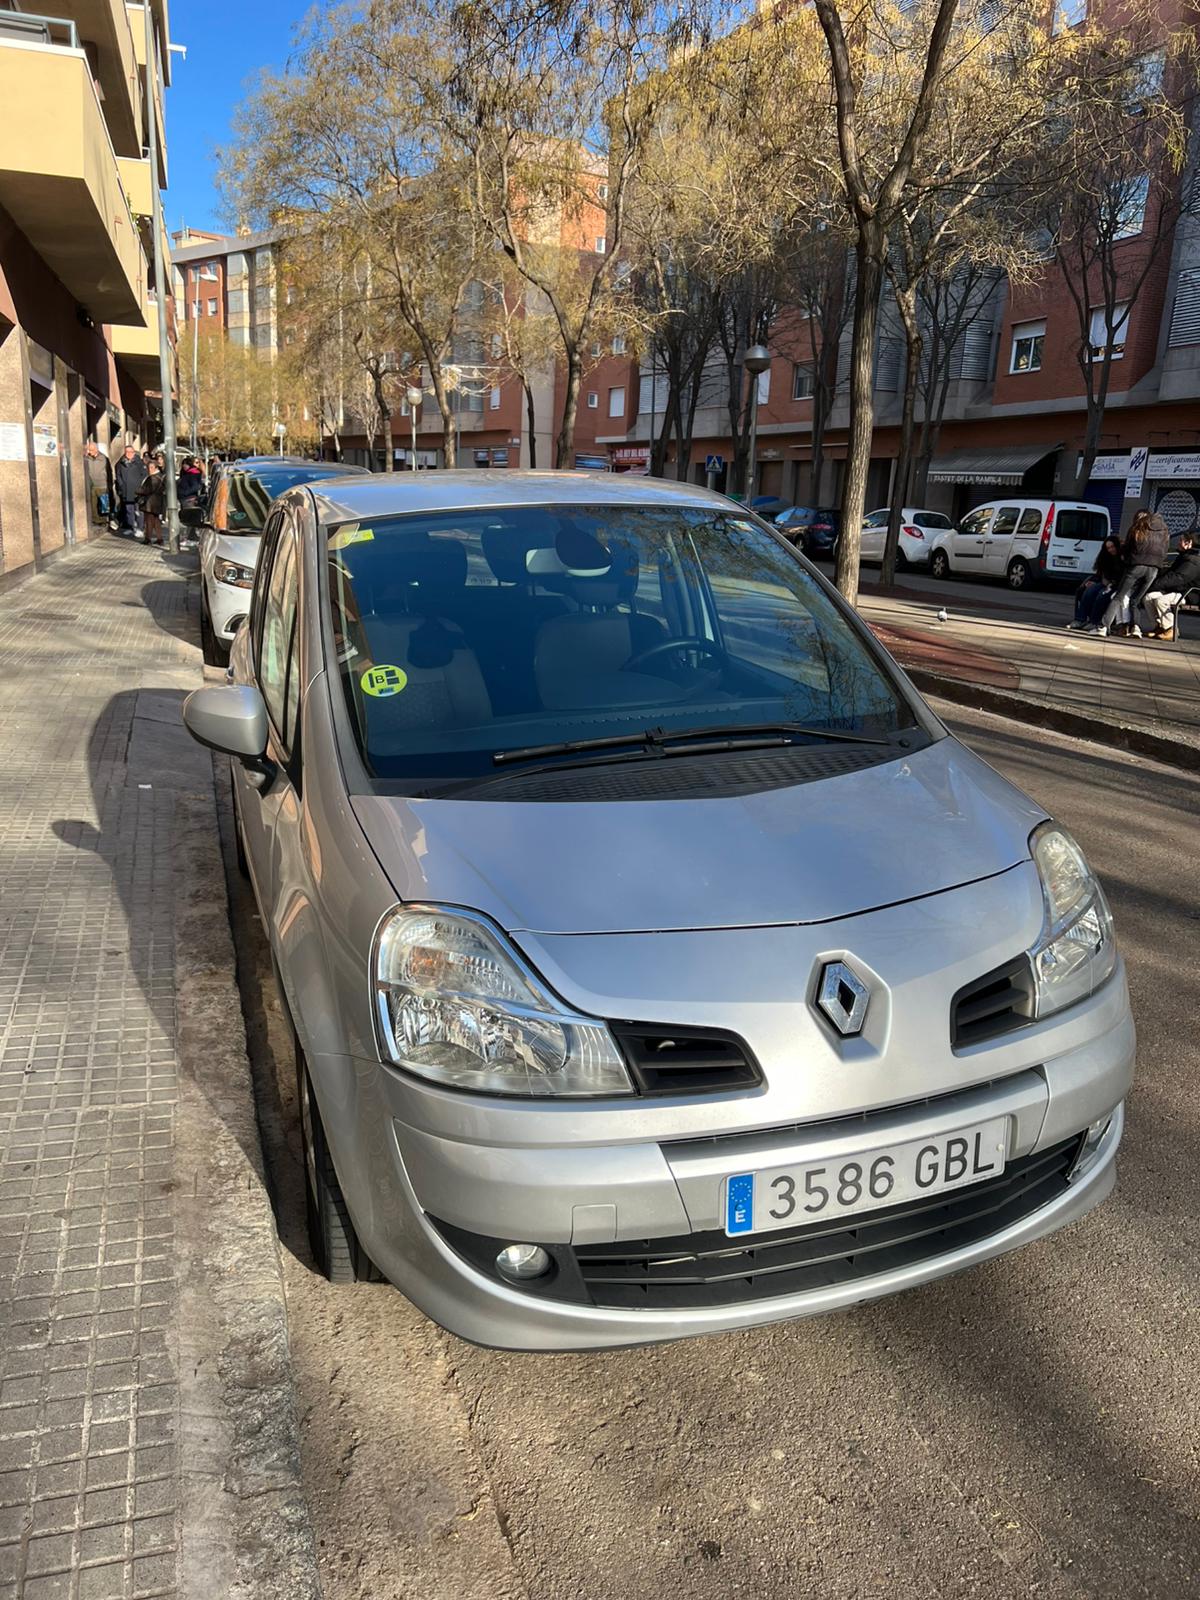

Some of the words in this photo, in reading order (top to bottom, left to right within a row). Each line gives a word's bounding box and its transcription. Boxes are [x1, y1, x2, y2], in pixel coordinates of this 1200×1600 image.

[375, 674, 385, 684] B
[768, 1155, 895, 1219] 3586
[914, 1132, 995, 1188] GBL
[735, 1210, 746, 1223] E
